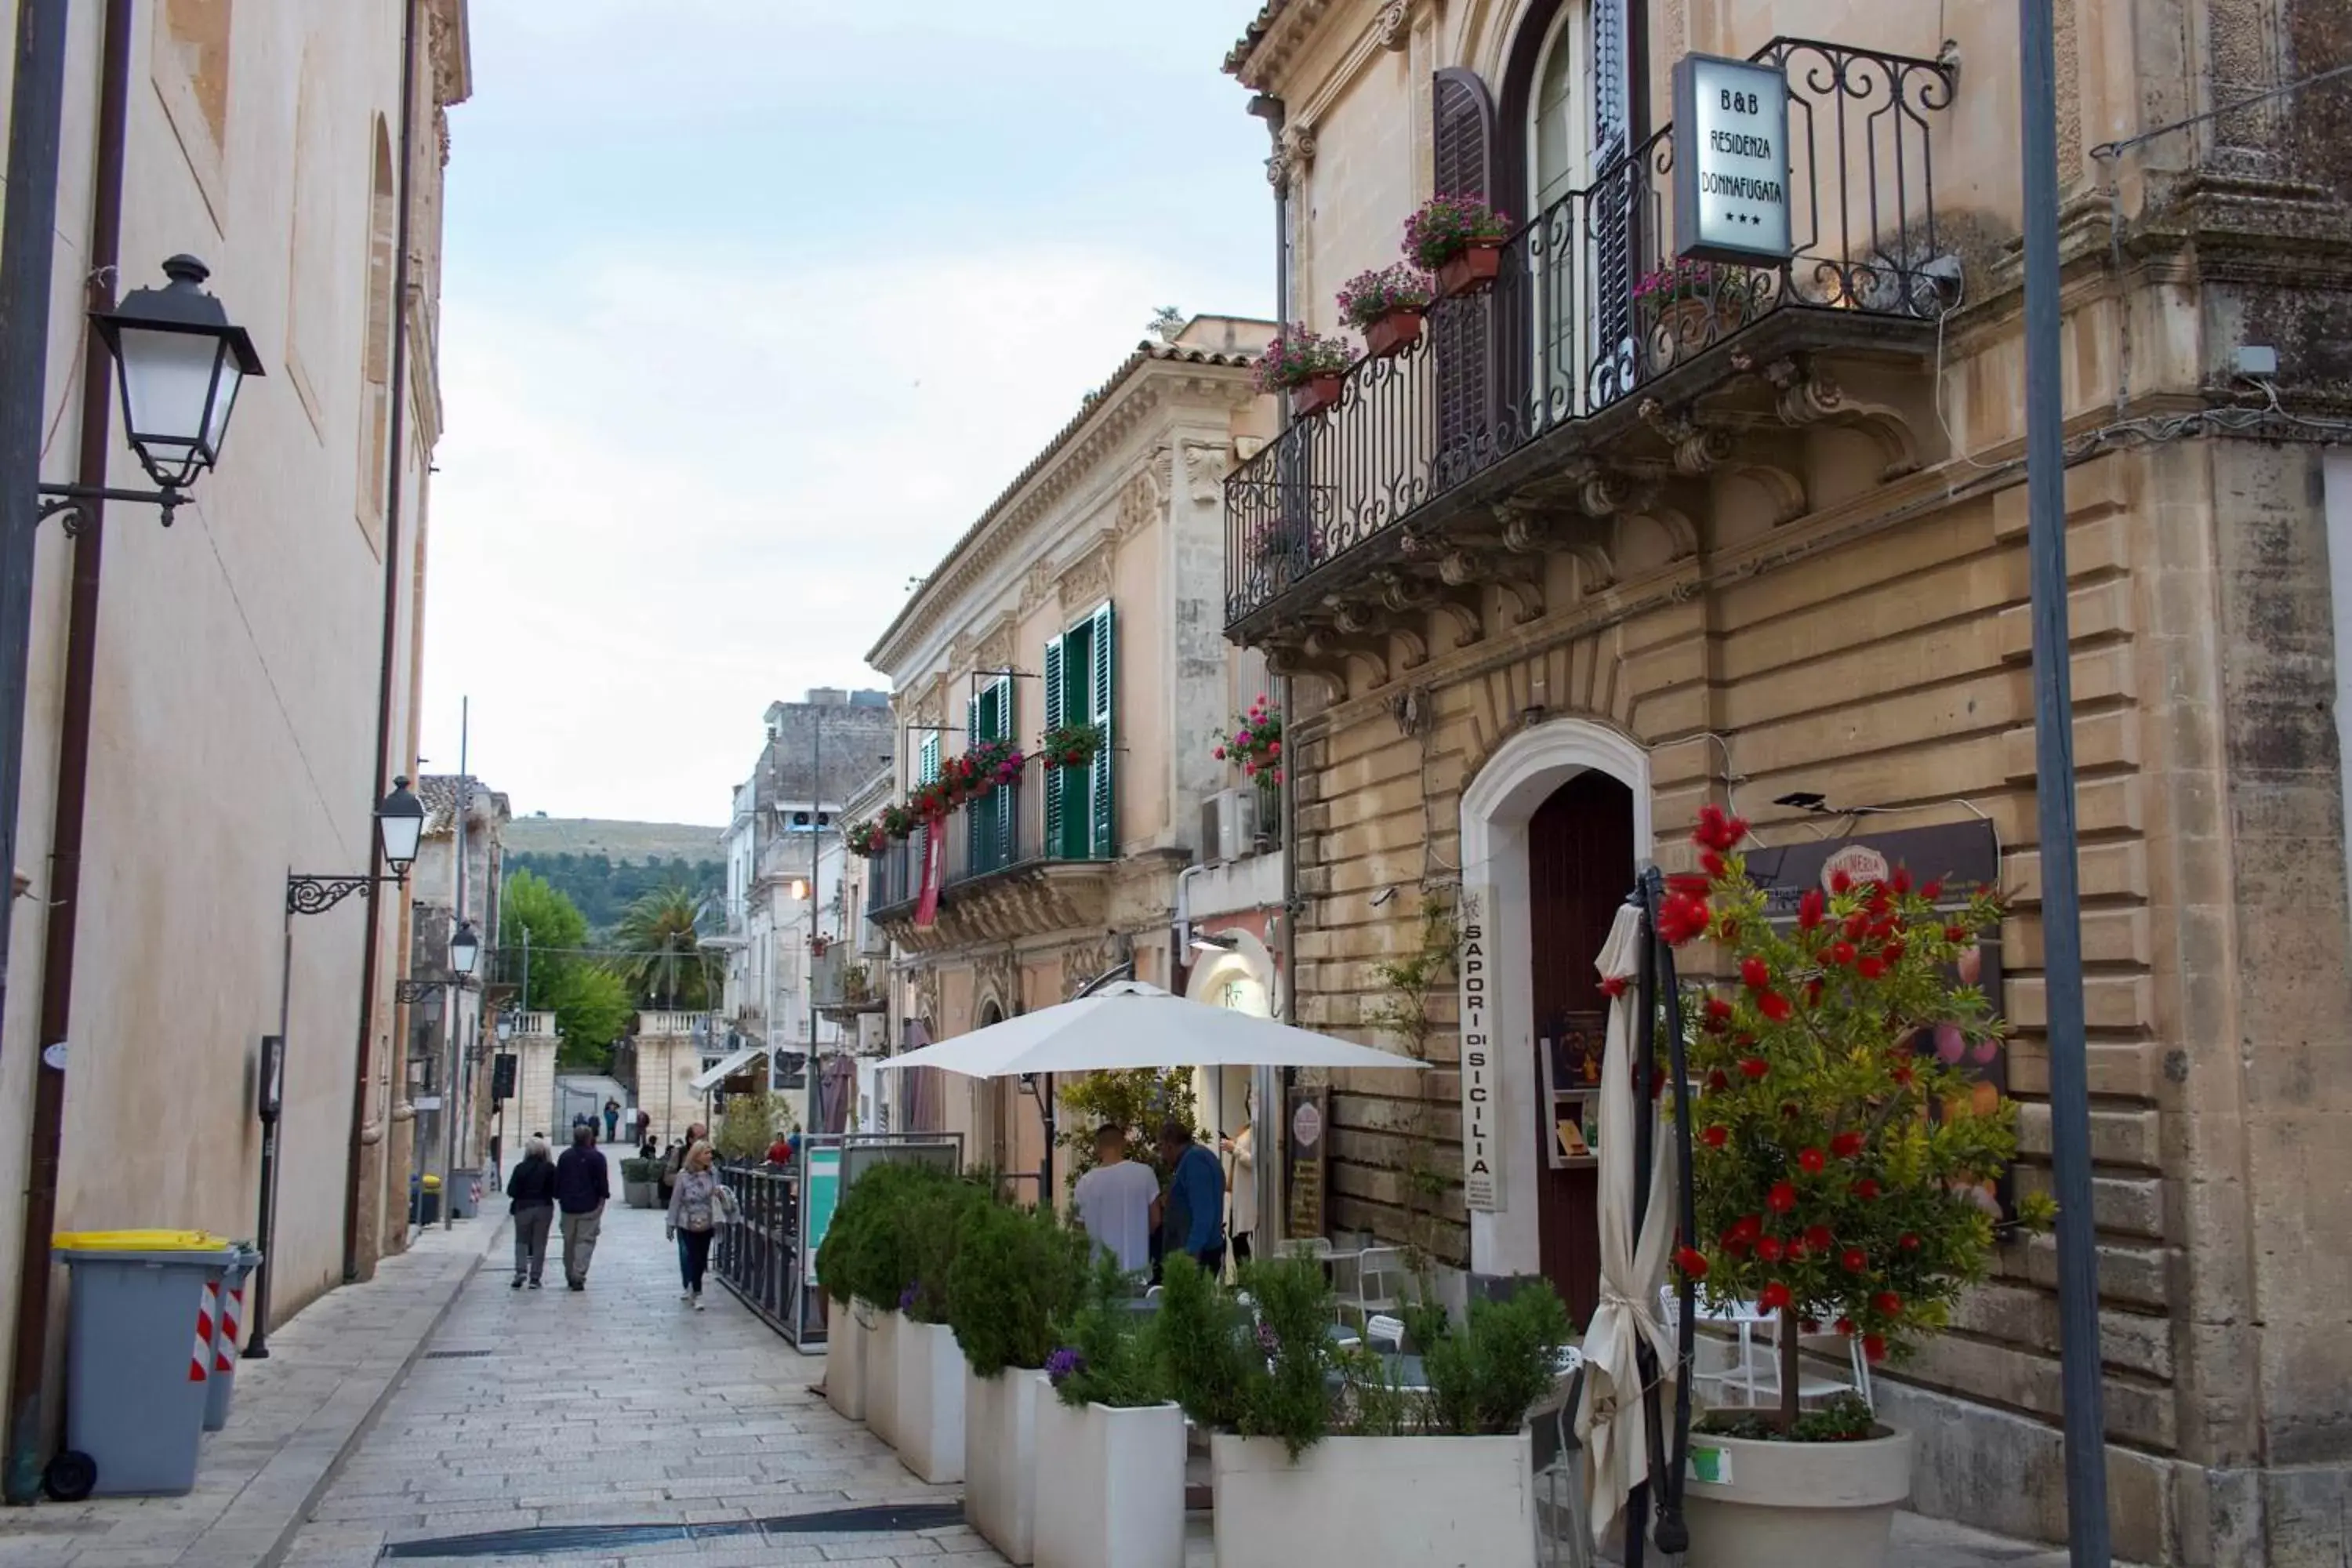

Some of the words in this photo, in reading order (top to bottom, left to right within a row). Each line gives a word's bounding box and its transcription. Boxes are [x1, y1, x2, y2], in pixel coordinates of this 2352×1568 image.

[1711, 131, 1771, 159] RESIDENZA
[1701, 172, 1783, 205] DONNAFUGATA
[1465, 925, 1483, 1027] SAPORI
[1467, 1033, 1487, 1045] DI
[1468, 1052, 1490, 1174] SICILIA
